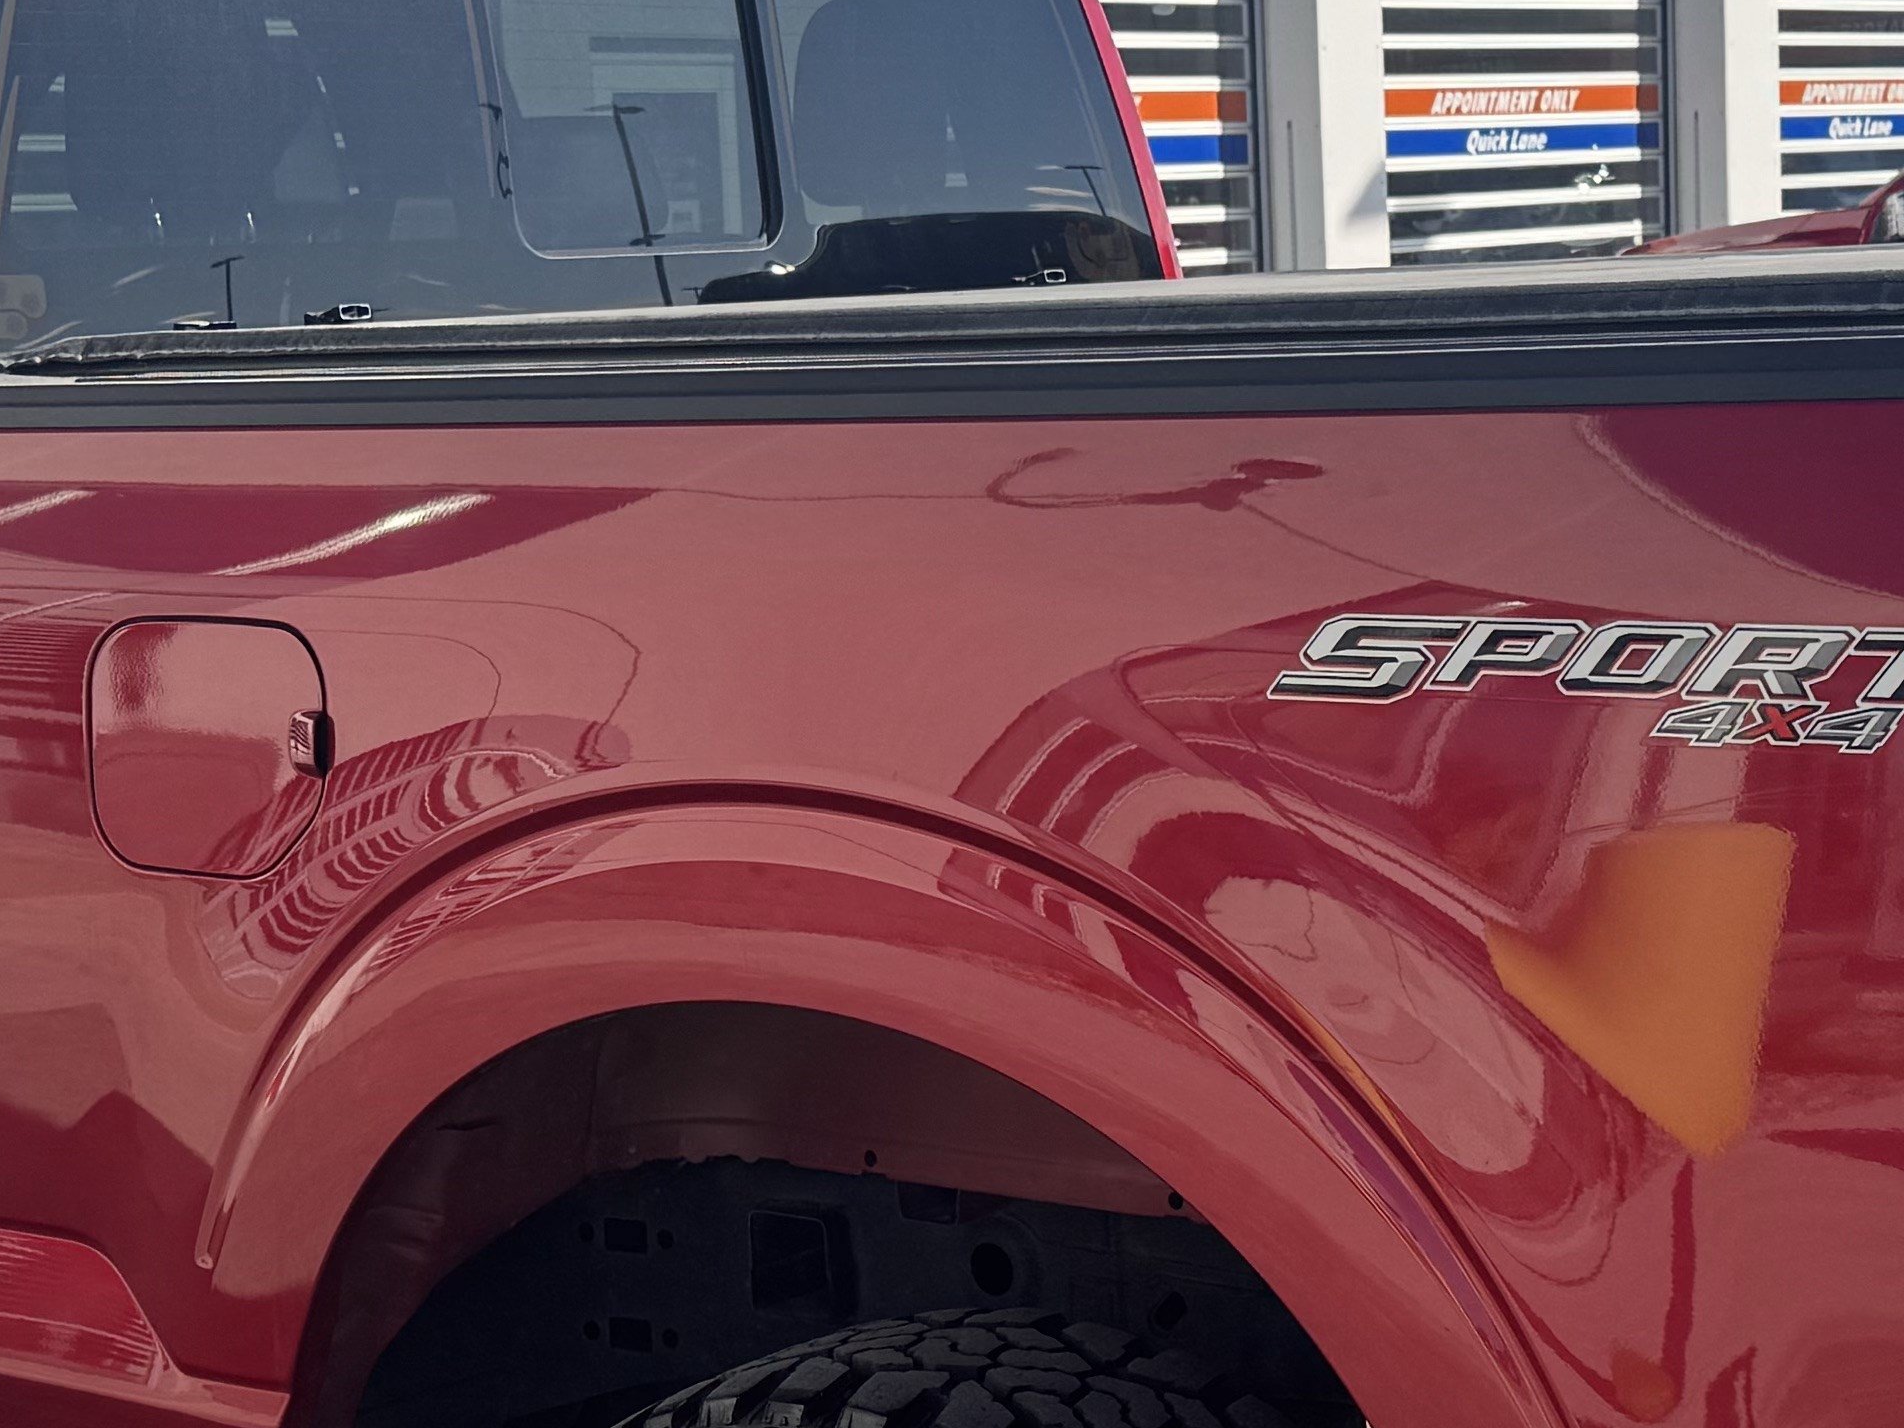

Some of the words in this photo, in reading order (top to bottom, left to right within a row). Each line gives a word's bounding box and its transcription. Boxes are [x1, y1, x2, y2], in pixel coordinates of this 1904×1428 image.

[1430, 88, 1539, 116] APPOINTMENT
[1539, 87, 1580, 113] ONLY
[1466, 128, 1508, 156] Quick
[1509, 129, 1548, 152] Lane
